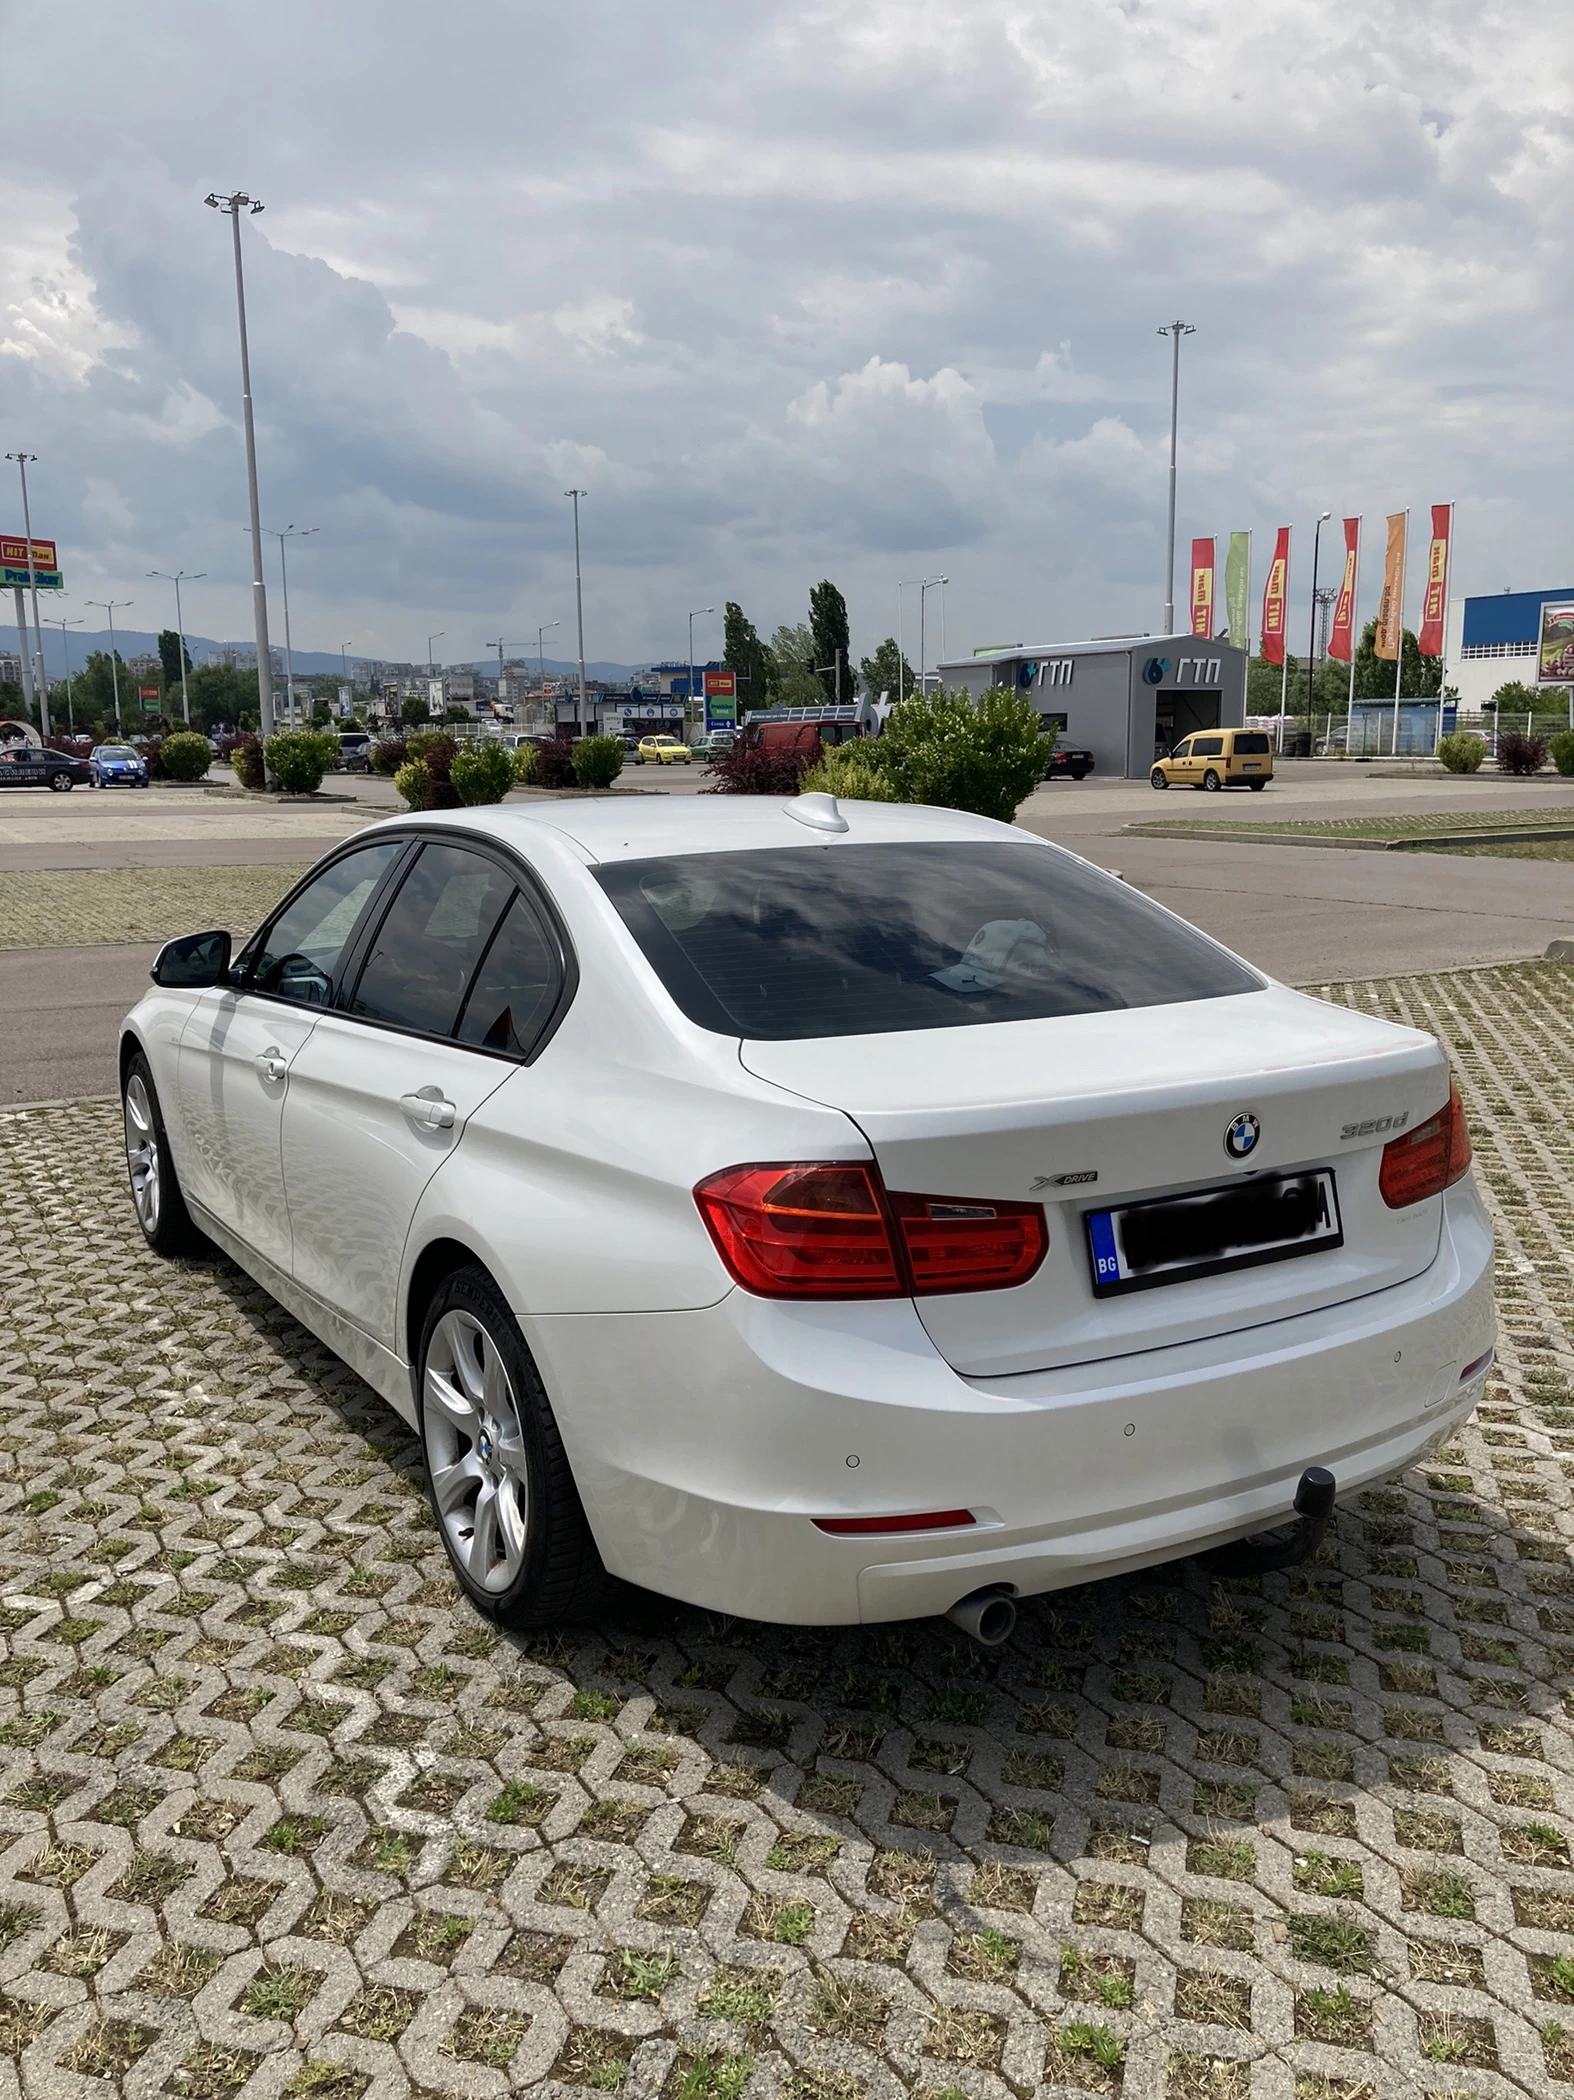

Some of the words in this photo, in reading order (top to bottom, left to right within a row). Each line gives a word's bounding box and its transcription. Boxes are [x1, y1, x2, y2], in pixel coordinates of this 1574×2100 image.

[6, 546, 25, 557] HIT
[1037, 659, 1074, 686] ГТП
[1176, 657, 1222, 684] ГТП
[1230, 1114, 1260, 1131] BMW
[1340, 1111, 1409, 1140] 320d
[1098, 1257, 1117, 1274] BG
[454, 1281, 508, 1335] SEMPERIT
